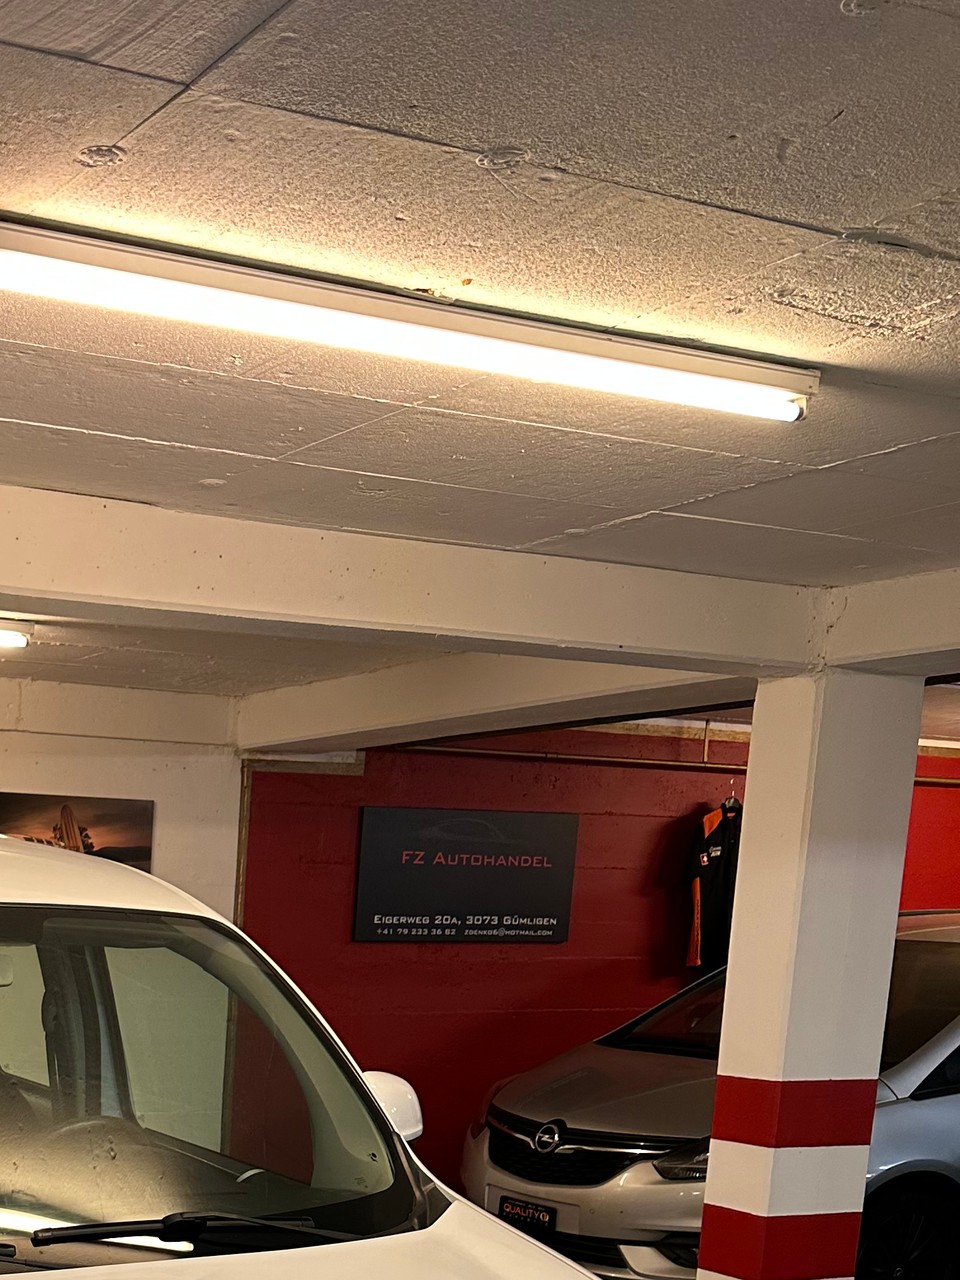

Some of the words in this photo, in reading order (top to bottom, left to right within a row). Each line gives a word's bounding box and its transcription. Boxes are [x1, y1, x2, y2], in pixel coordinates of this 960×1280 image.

[401, 851, 425, 864] FZ
[433, 851, 552, 867] AUTOHANDEL
[373, 915, 430, 924] EIGERWEG
[465, 916, 498, 925] 3073
